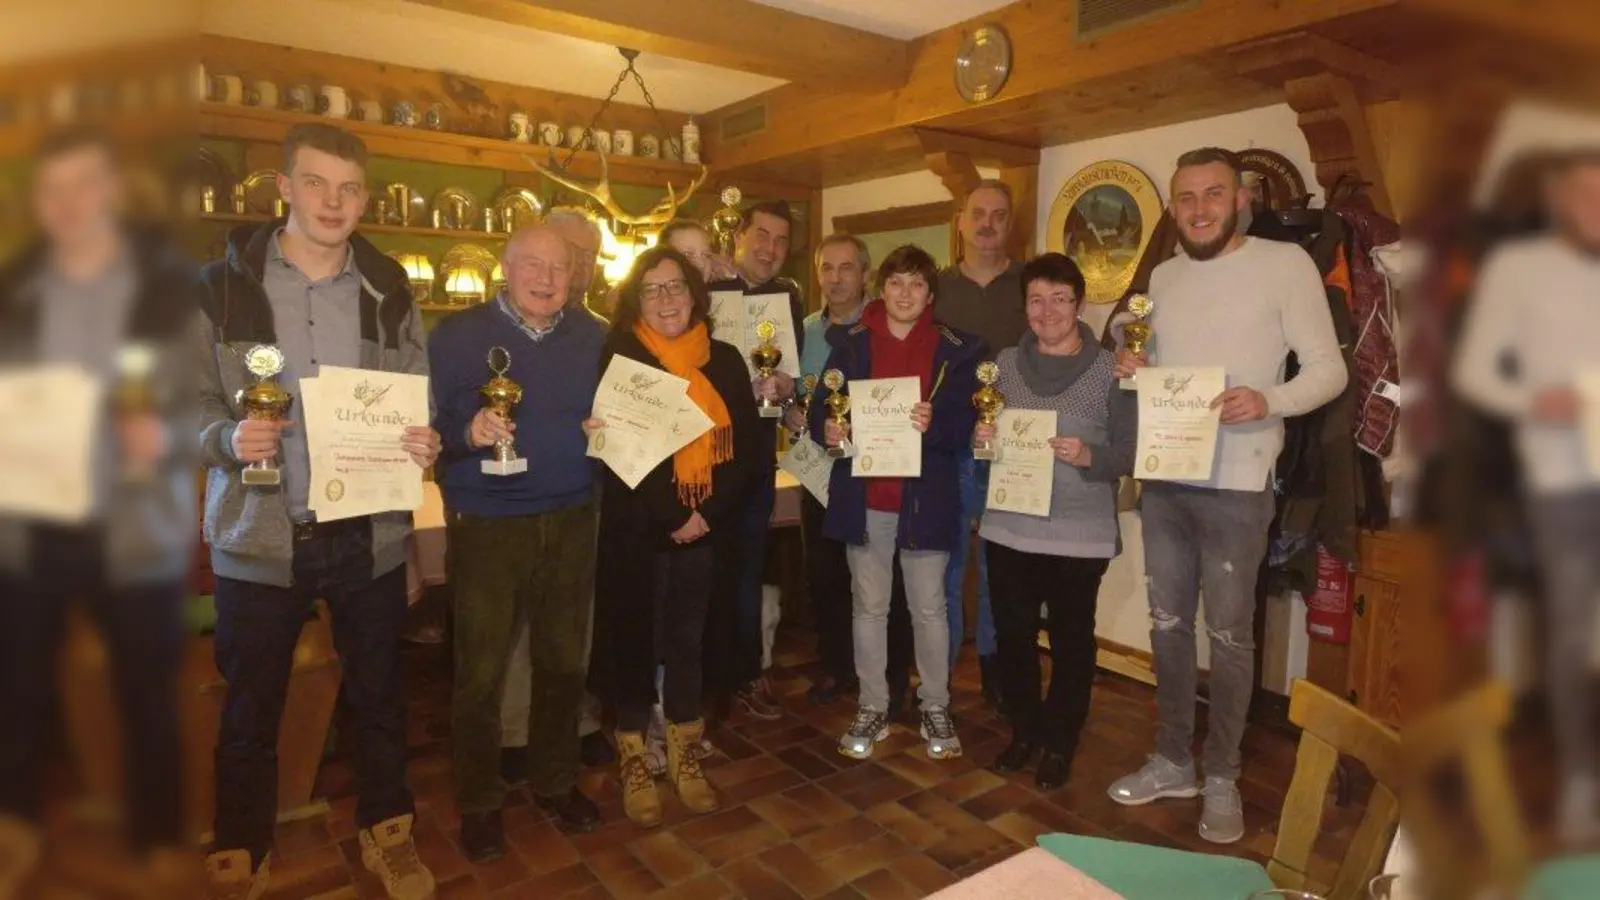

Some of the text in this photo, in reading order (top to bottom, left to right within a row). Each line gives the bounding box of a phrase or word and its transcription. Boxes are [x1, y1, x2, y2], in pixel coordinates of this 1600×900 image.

[613, 382, 667, 409] Urkunde
[1150, 395, 1209, 411] Urkunde
[335, 407, 412, 427] Urkunde
[862, 403, 911, 417] Urkunde
[1003, 437, 1045, 450] Urkunde
